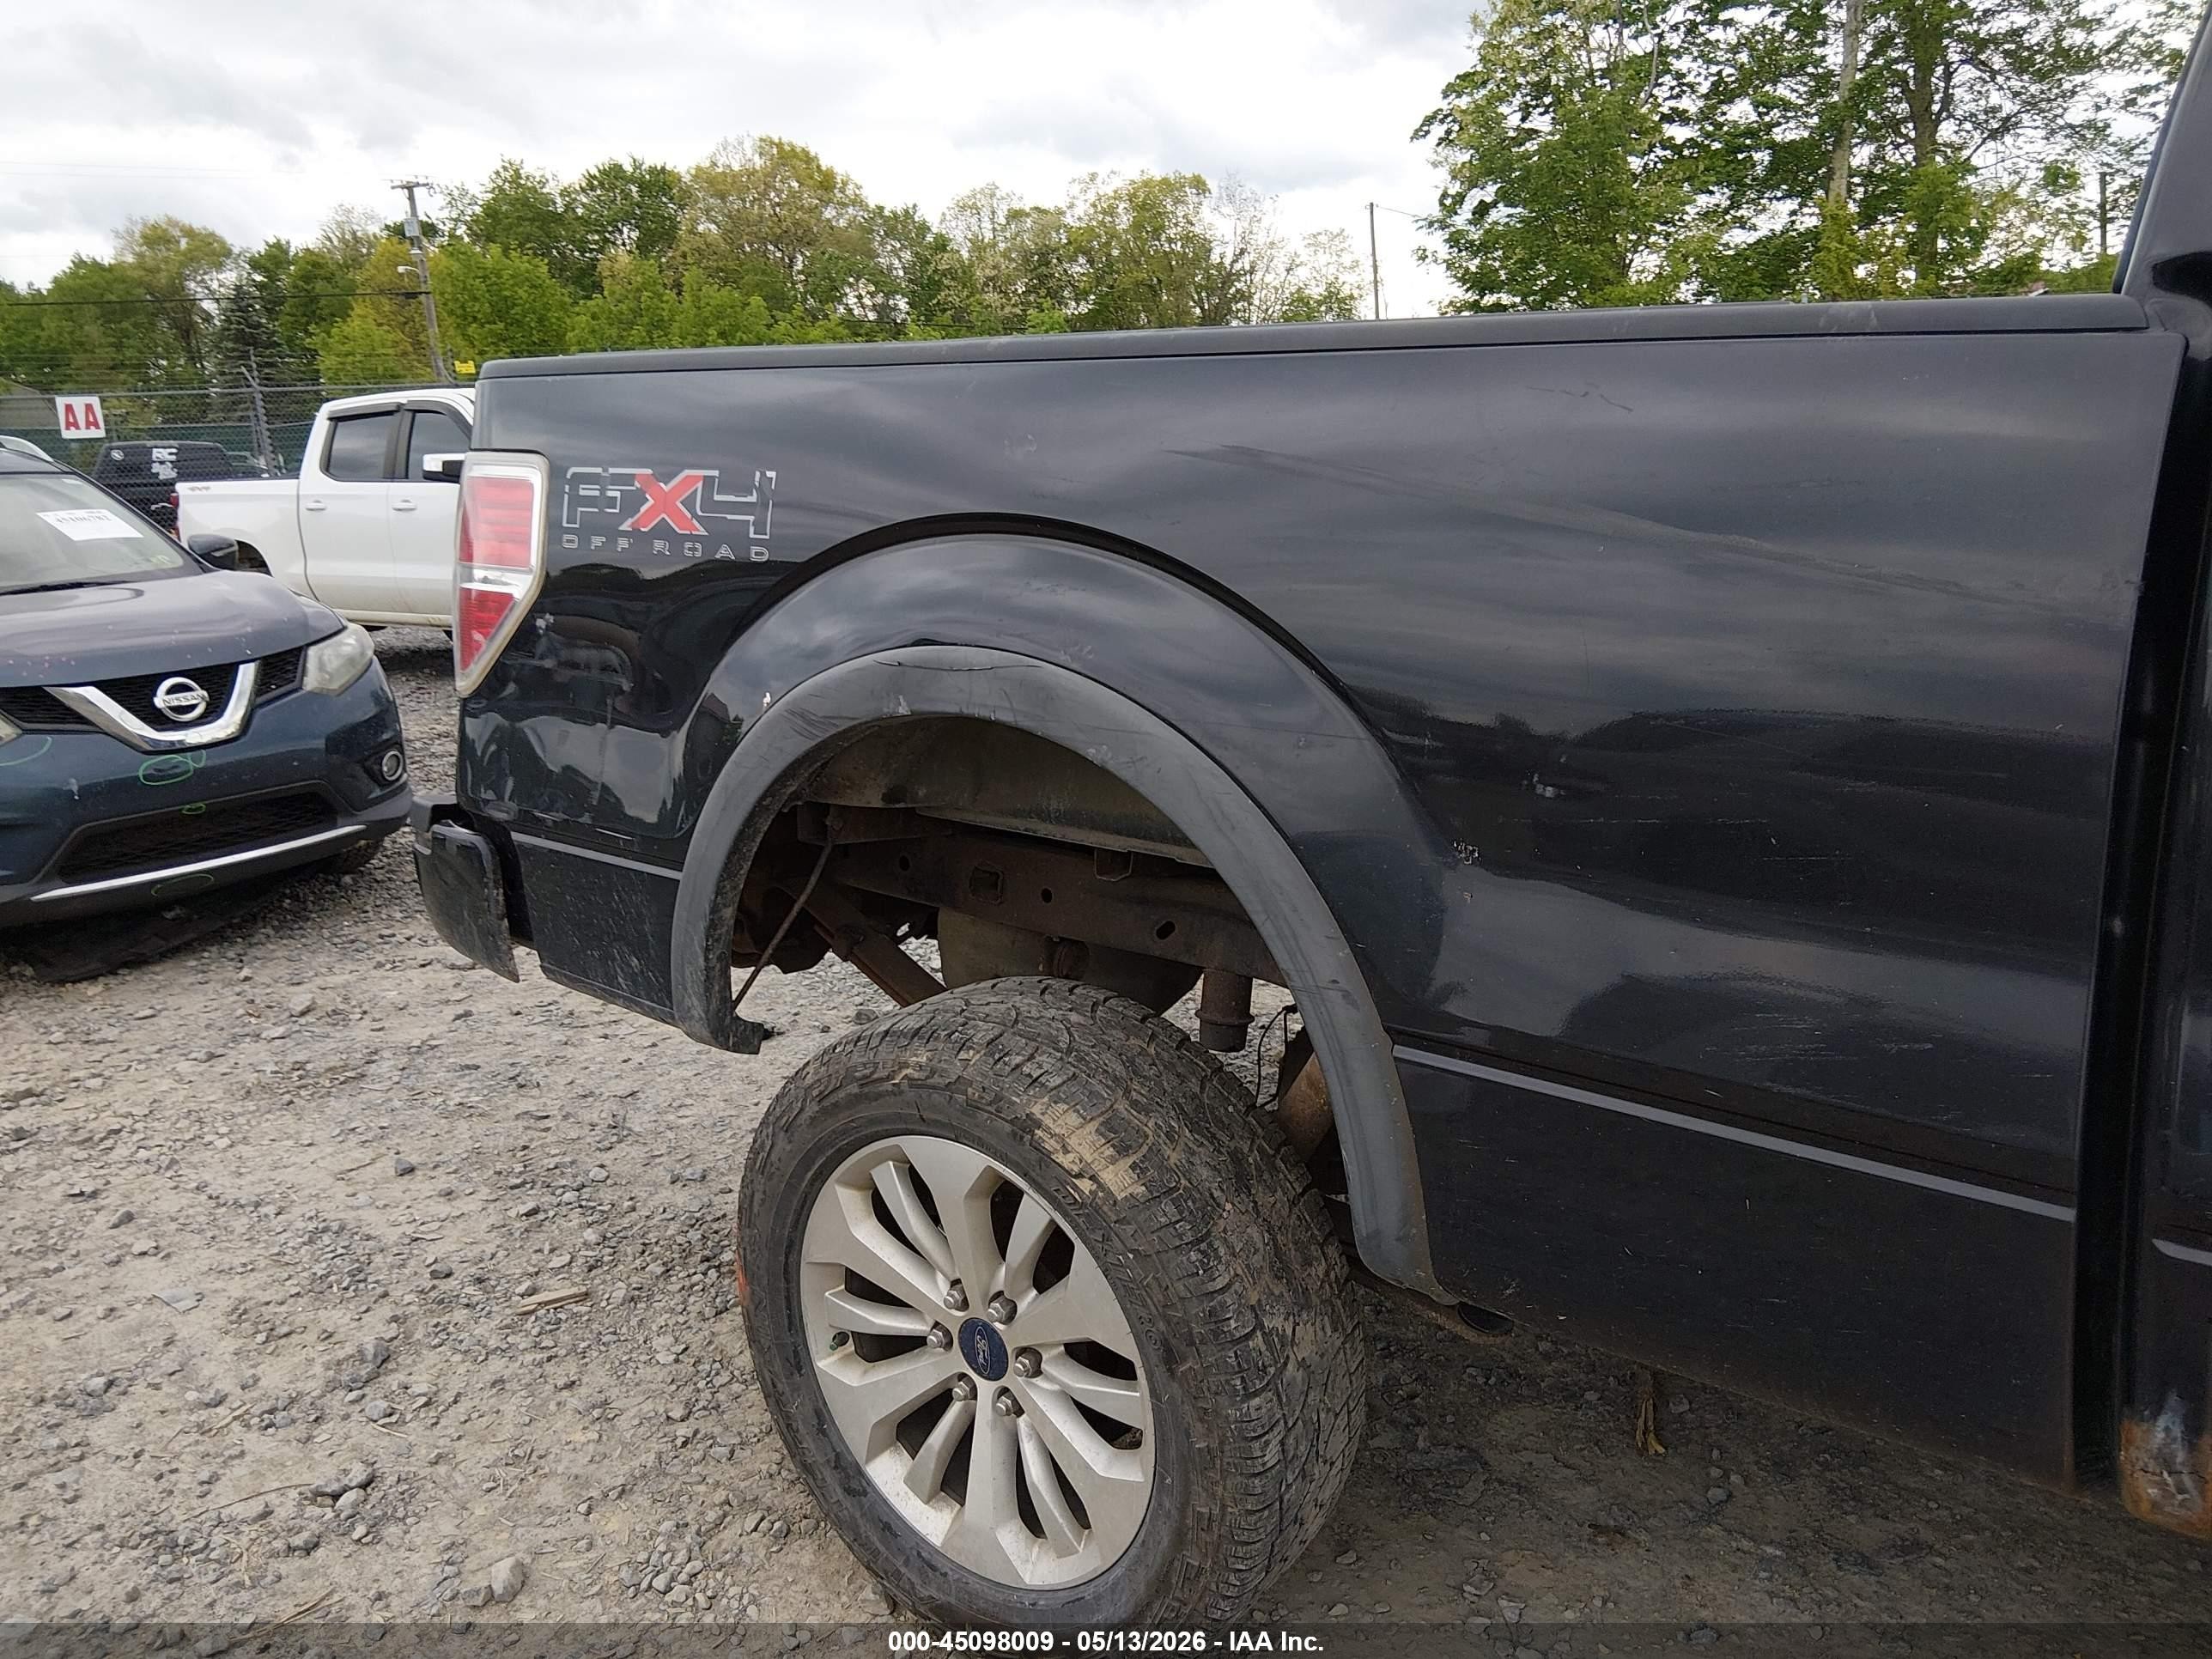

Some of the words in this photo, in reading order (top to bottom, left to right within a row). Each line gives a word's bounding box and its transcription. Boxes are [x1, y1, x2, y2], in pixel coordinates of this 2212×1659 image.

[64, 403, 101, 430] AA
[562, 466, 777, 539] FX4
[162, 692, 208, 706] NISSAN
